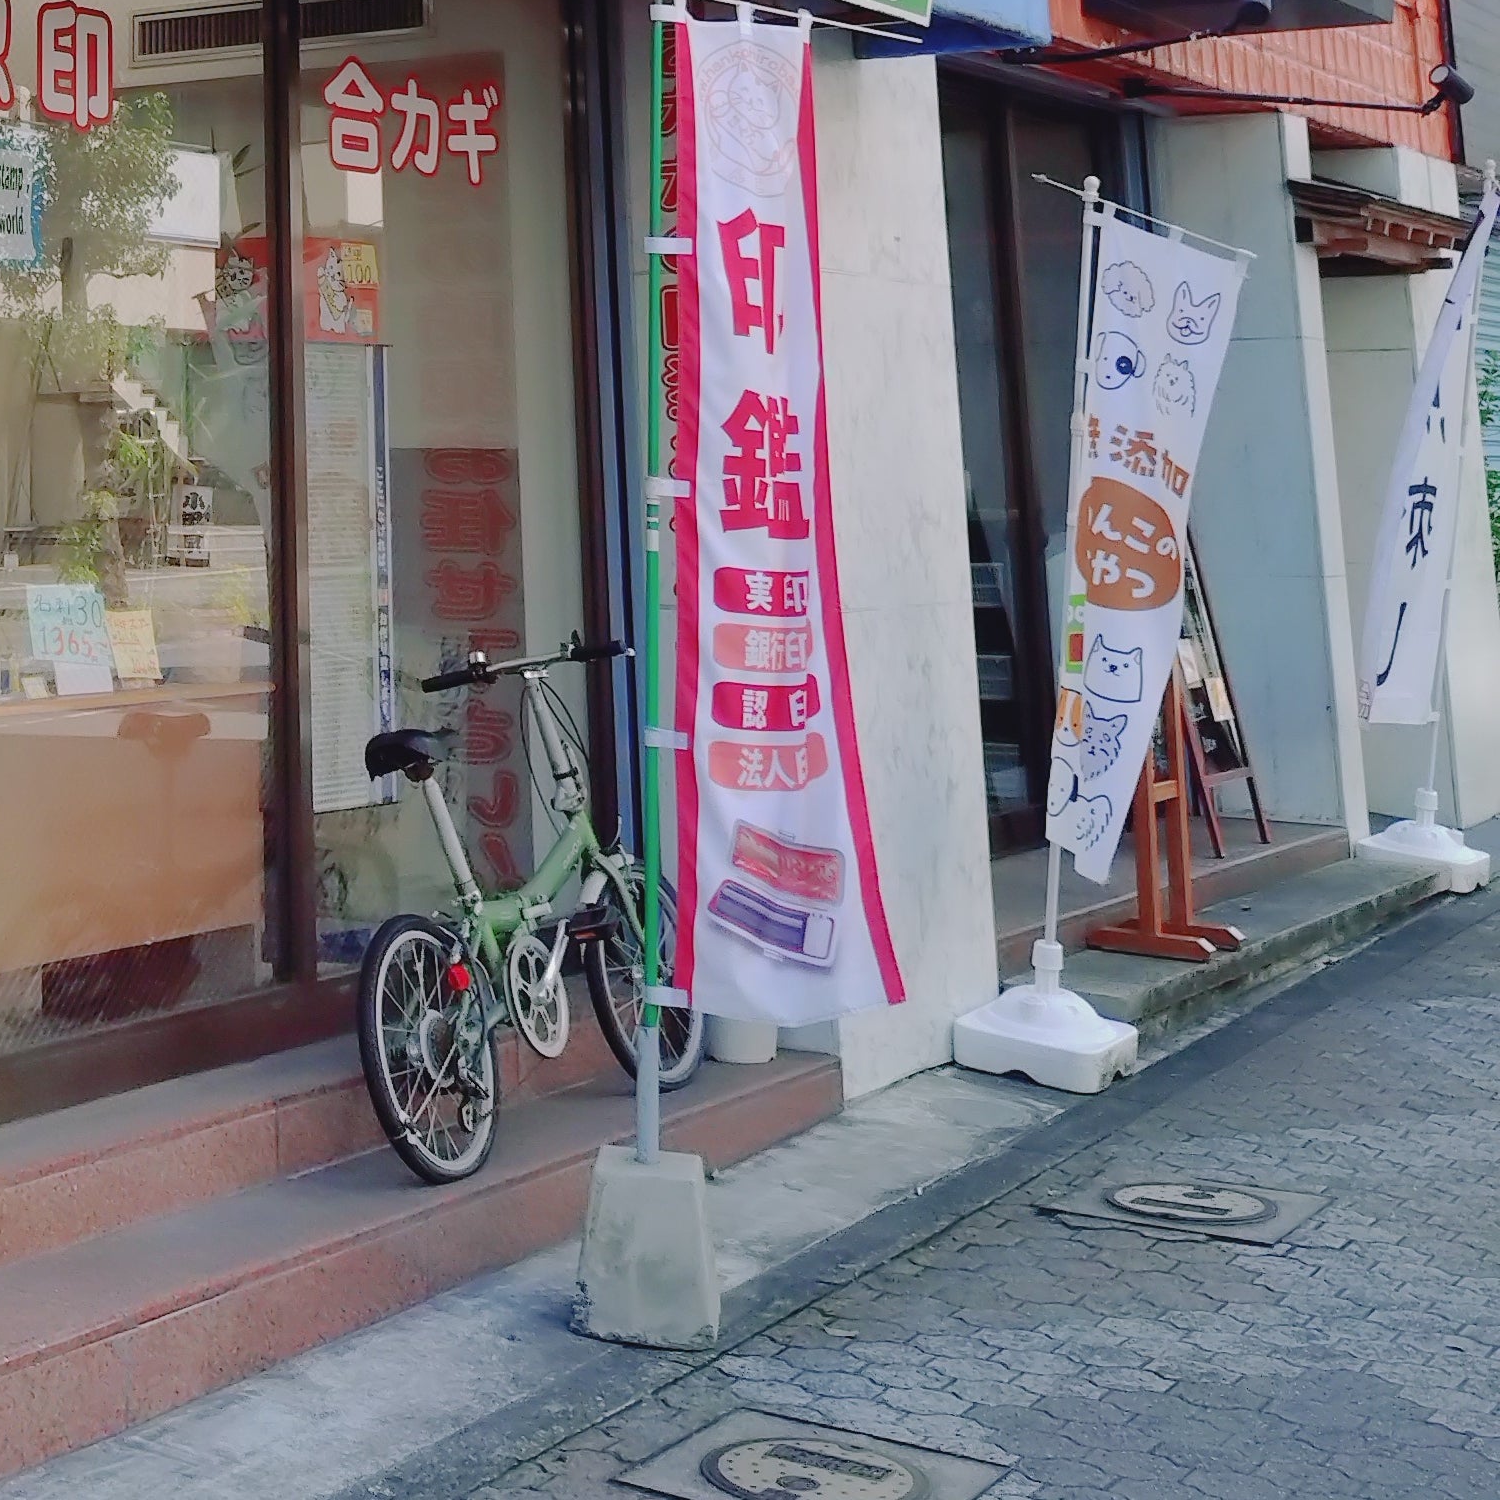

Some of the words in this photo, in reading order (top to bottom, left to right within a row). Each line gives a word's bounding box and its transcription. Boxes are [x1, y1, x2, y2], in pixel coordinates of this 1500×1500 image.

[324, 55, 499, 187] 合カギ
[1087, 502, 1178, 562] んこの
[1086, 549, 1156, 599] やつ
